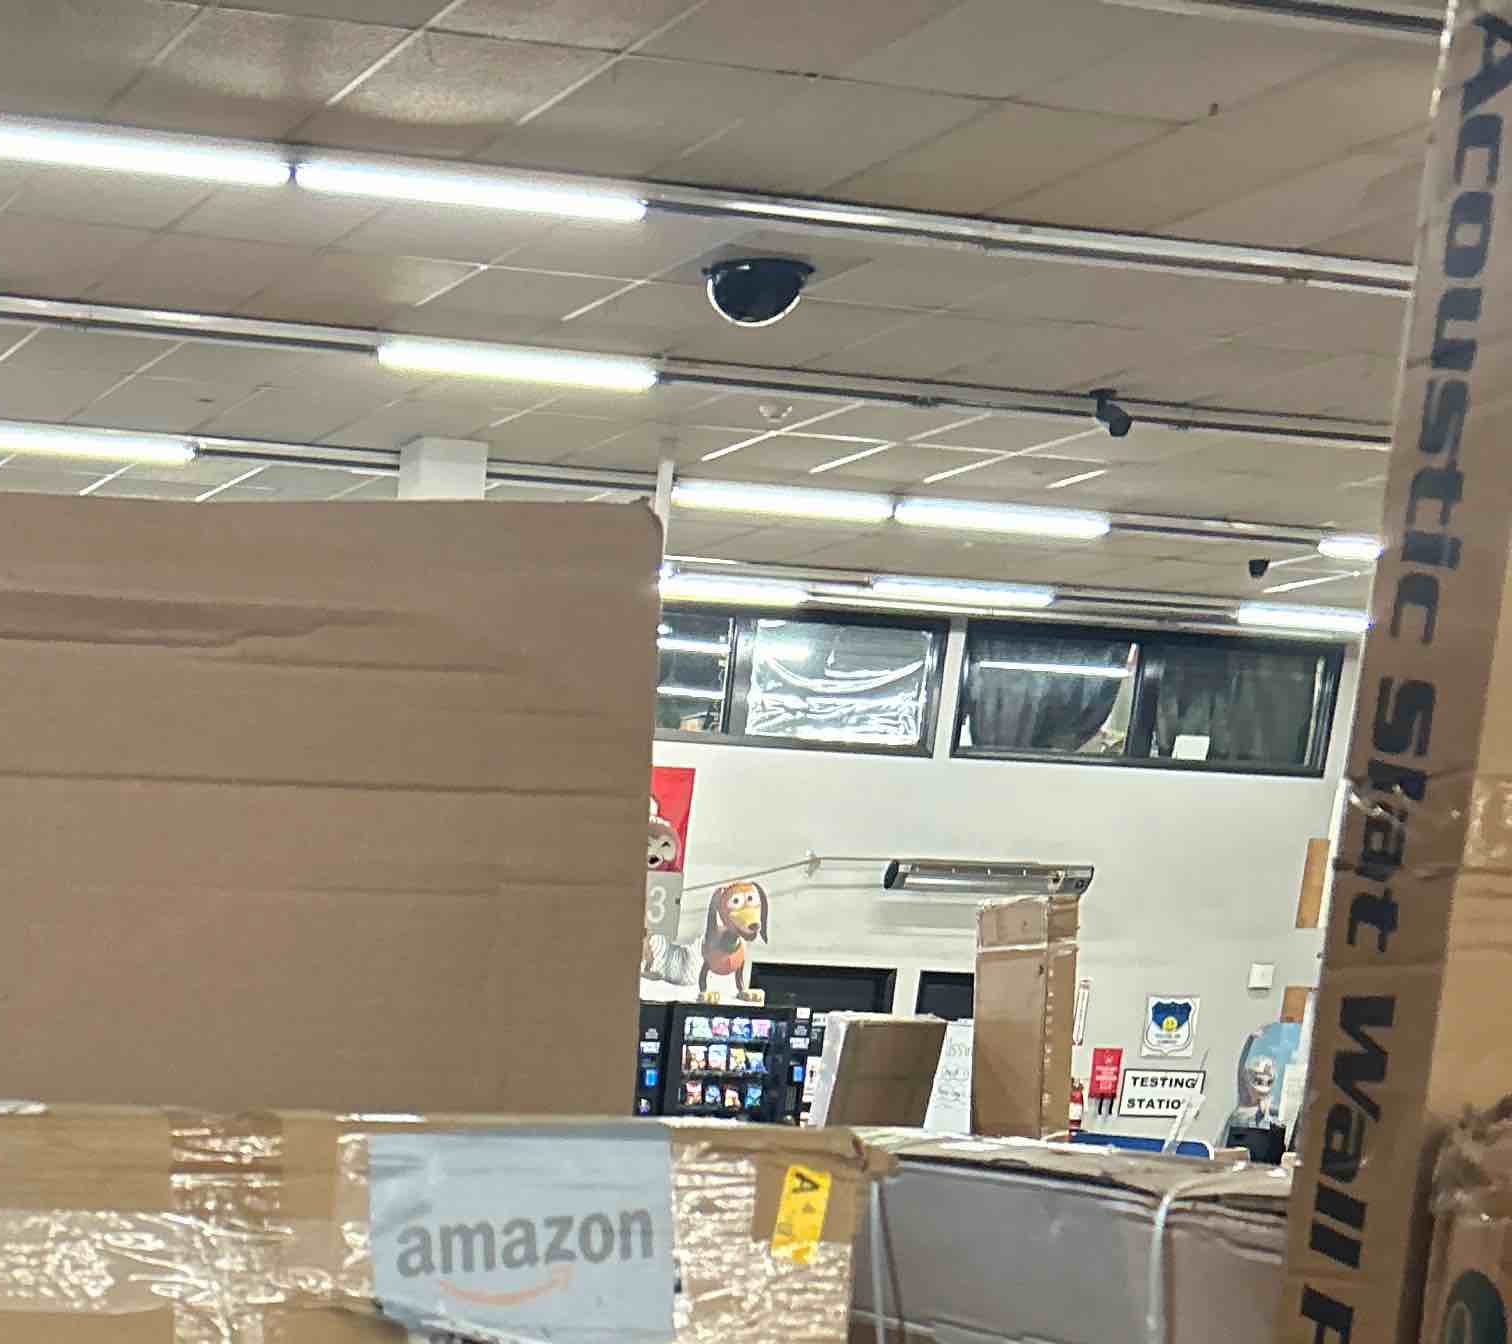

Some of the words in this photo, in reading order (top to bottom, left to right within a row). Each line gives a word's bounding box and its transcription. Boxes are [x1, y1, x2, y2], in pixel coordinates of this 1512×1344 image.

[1391, 12, 1512, 646] Acoustic
[1345, 676, 1436, 953] Slat
[646, 884, 667, 922] 3
[1127, 1098, 1185, 1110] STATIO
[1131, 1075, 1198, 1089] TESTING
[1310, 995, 1396, 1269] Wall
[395, 1206, 655, 1279] amazon
